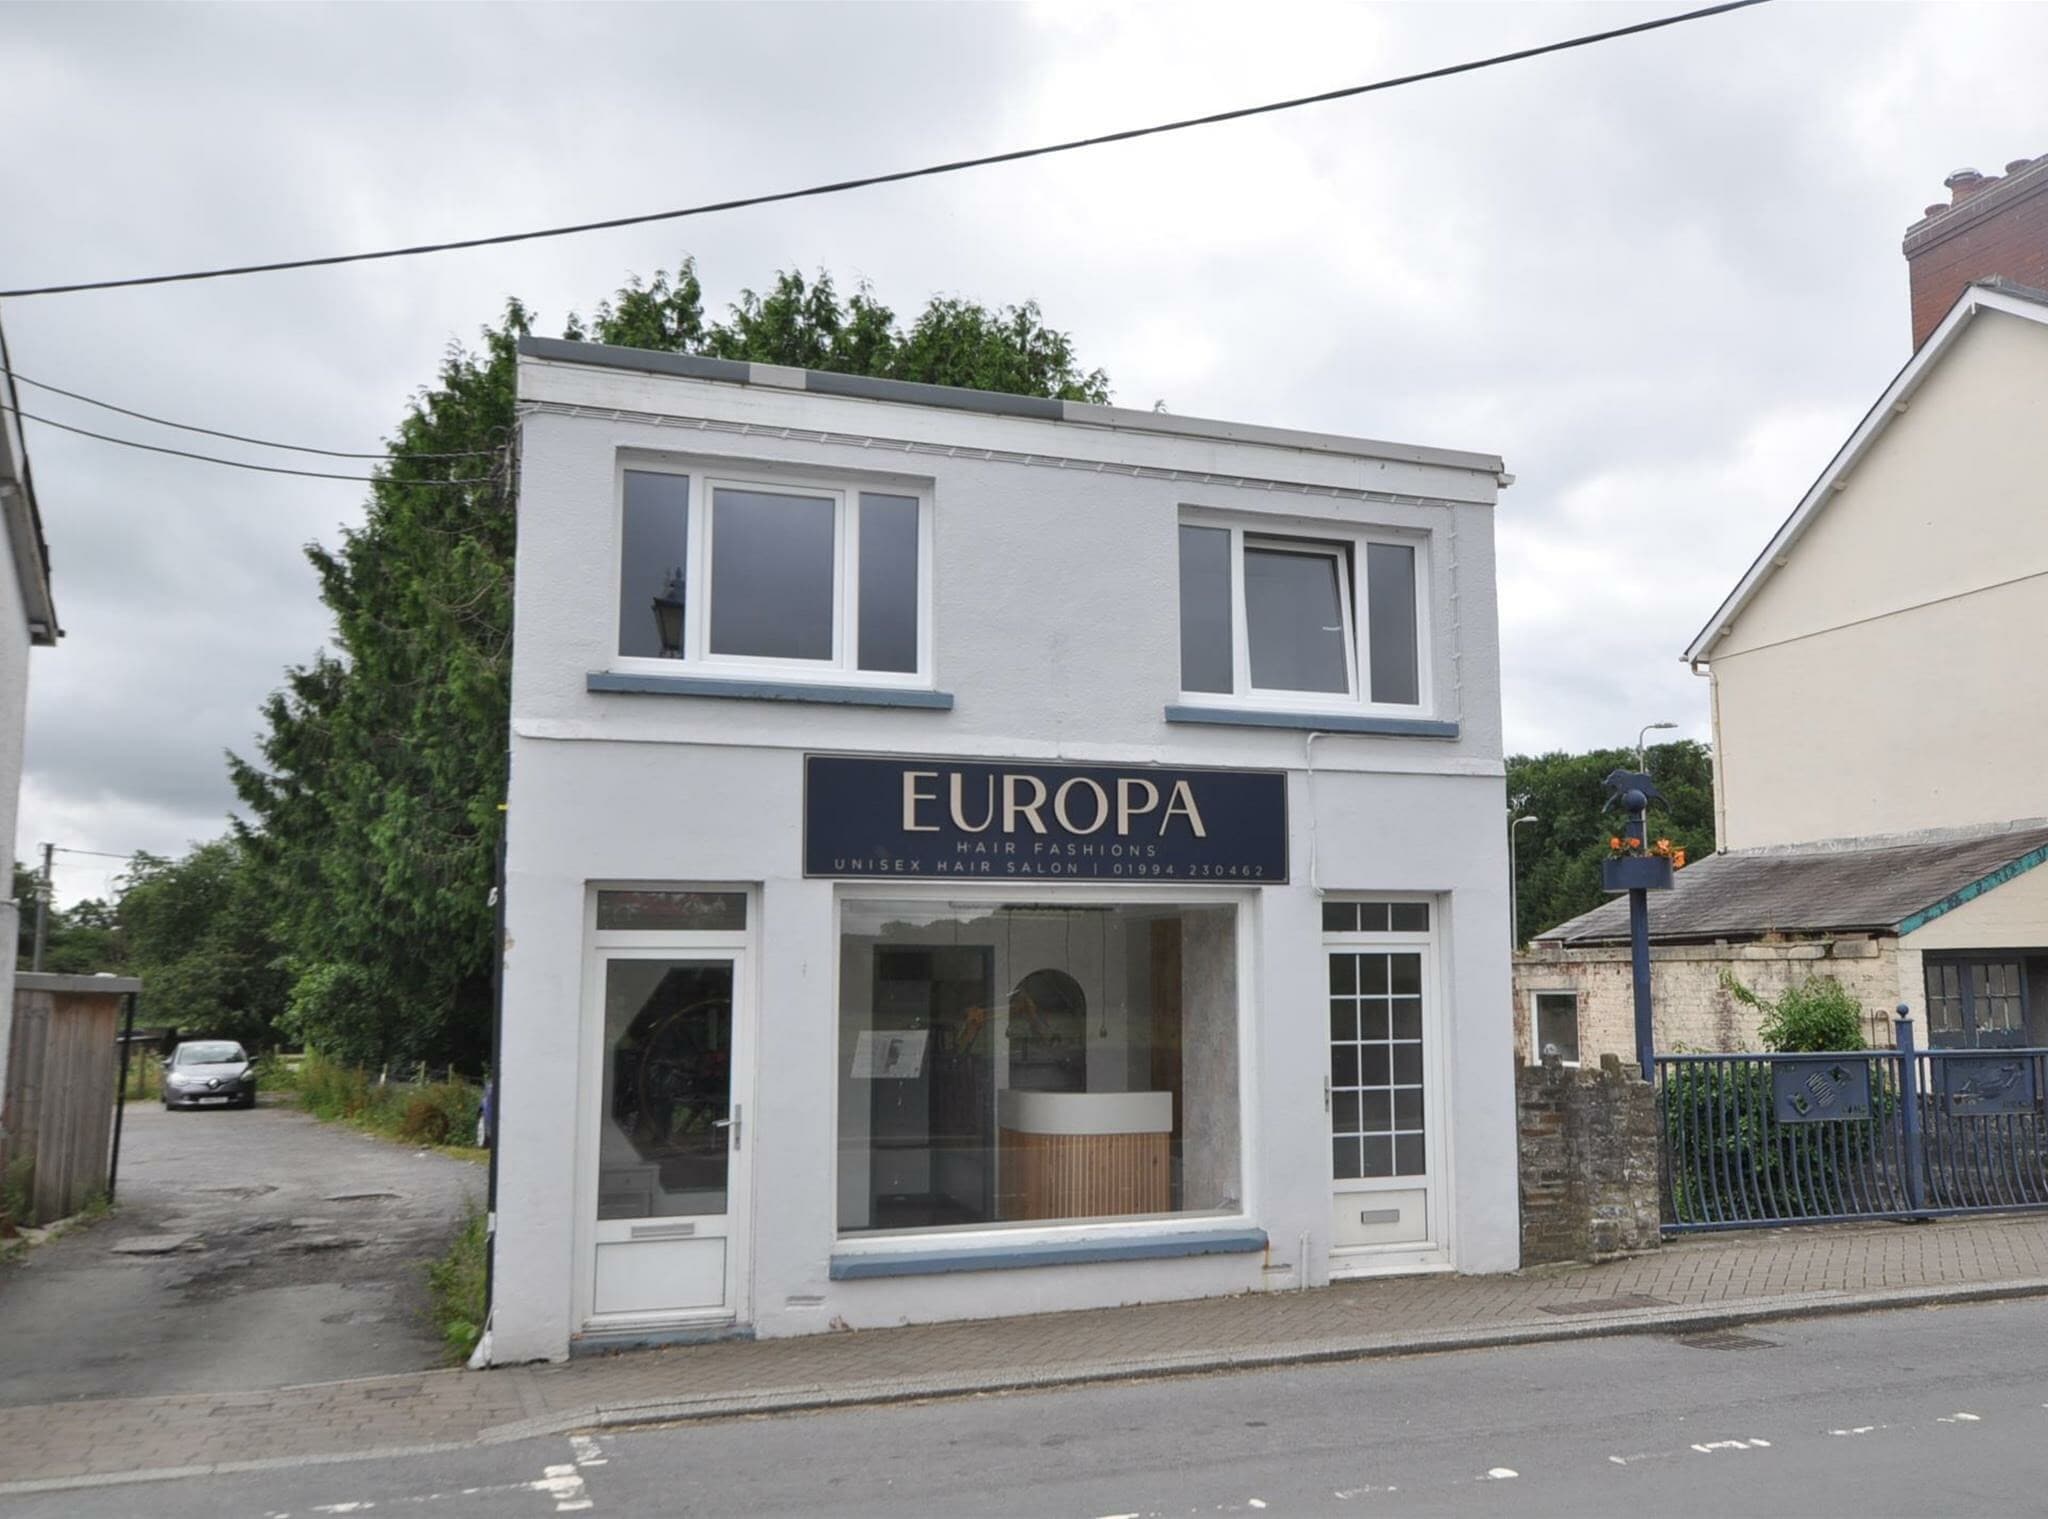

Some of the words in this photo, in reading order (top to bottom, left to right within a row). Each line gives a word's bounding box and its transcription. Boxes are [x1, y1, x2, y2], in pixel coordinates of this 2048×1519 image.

[902, 770, 1207, 838] EUROPA
[956, 841, 1016, 854] HAIR
[1034, 842, 1156, 857] FASHIONS
[834, 858, 920, 871] UNISEX
[937, 861, 991, 873] HAIR
[1007, 862, 1078, 874] SALON
[1113, 863, 1174, 875] 01994
[1189, 864, 1263, 876] 230462
